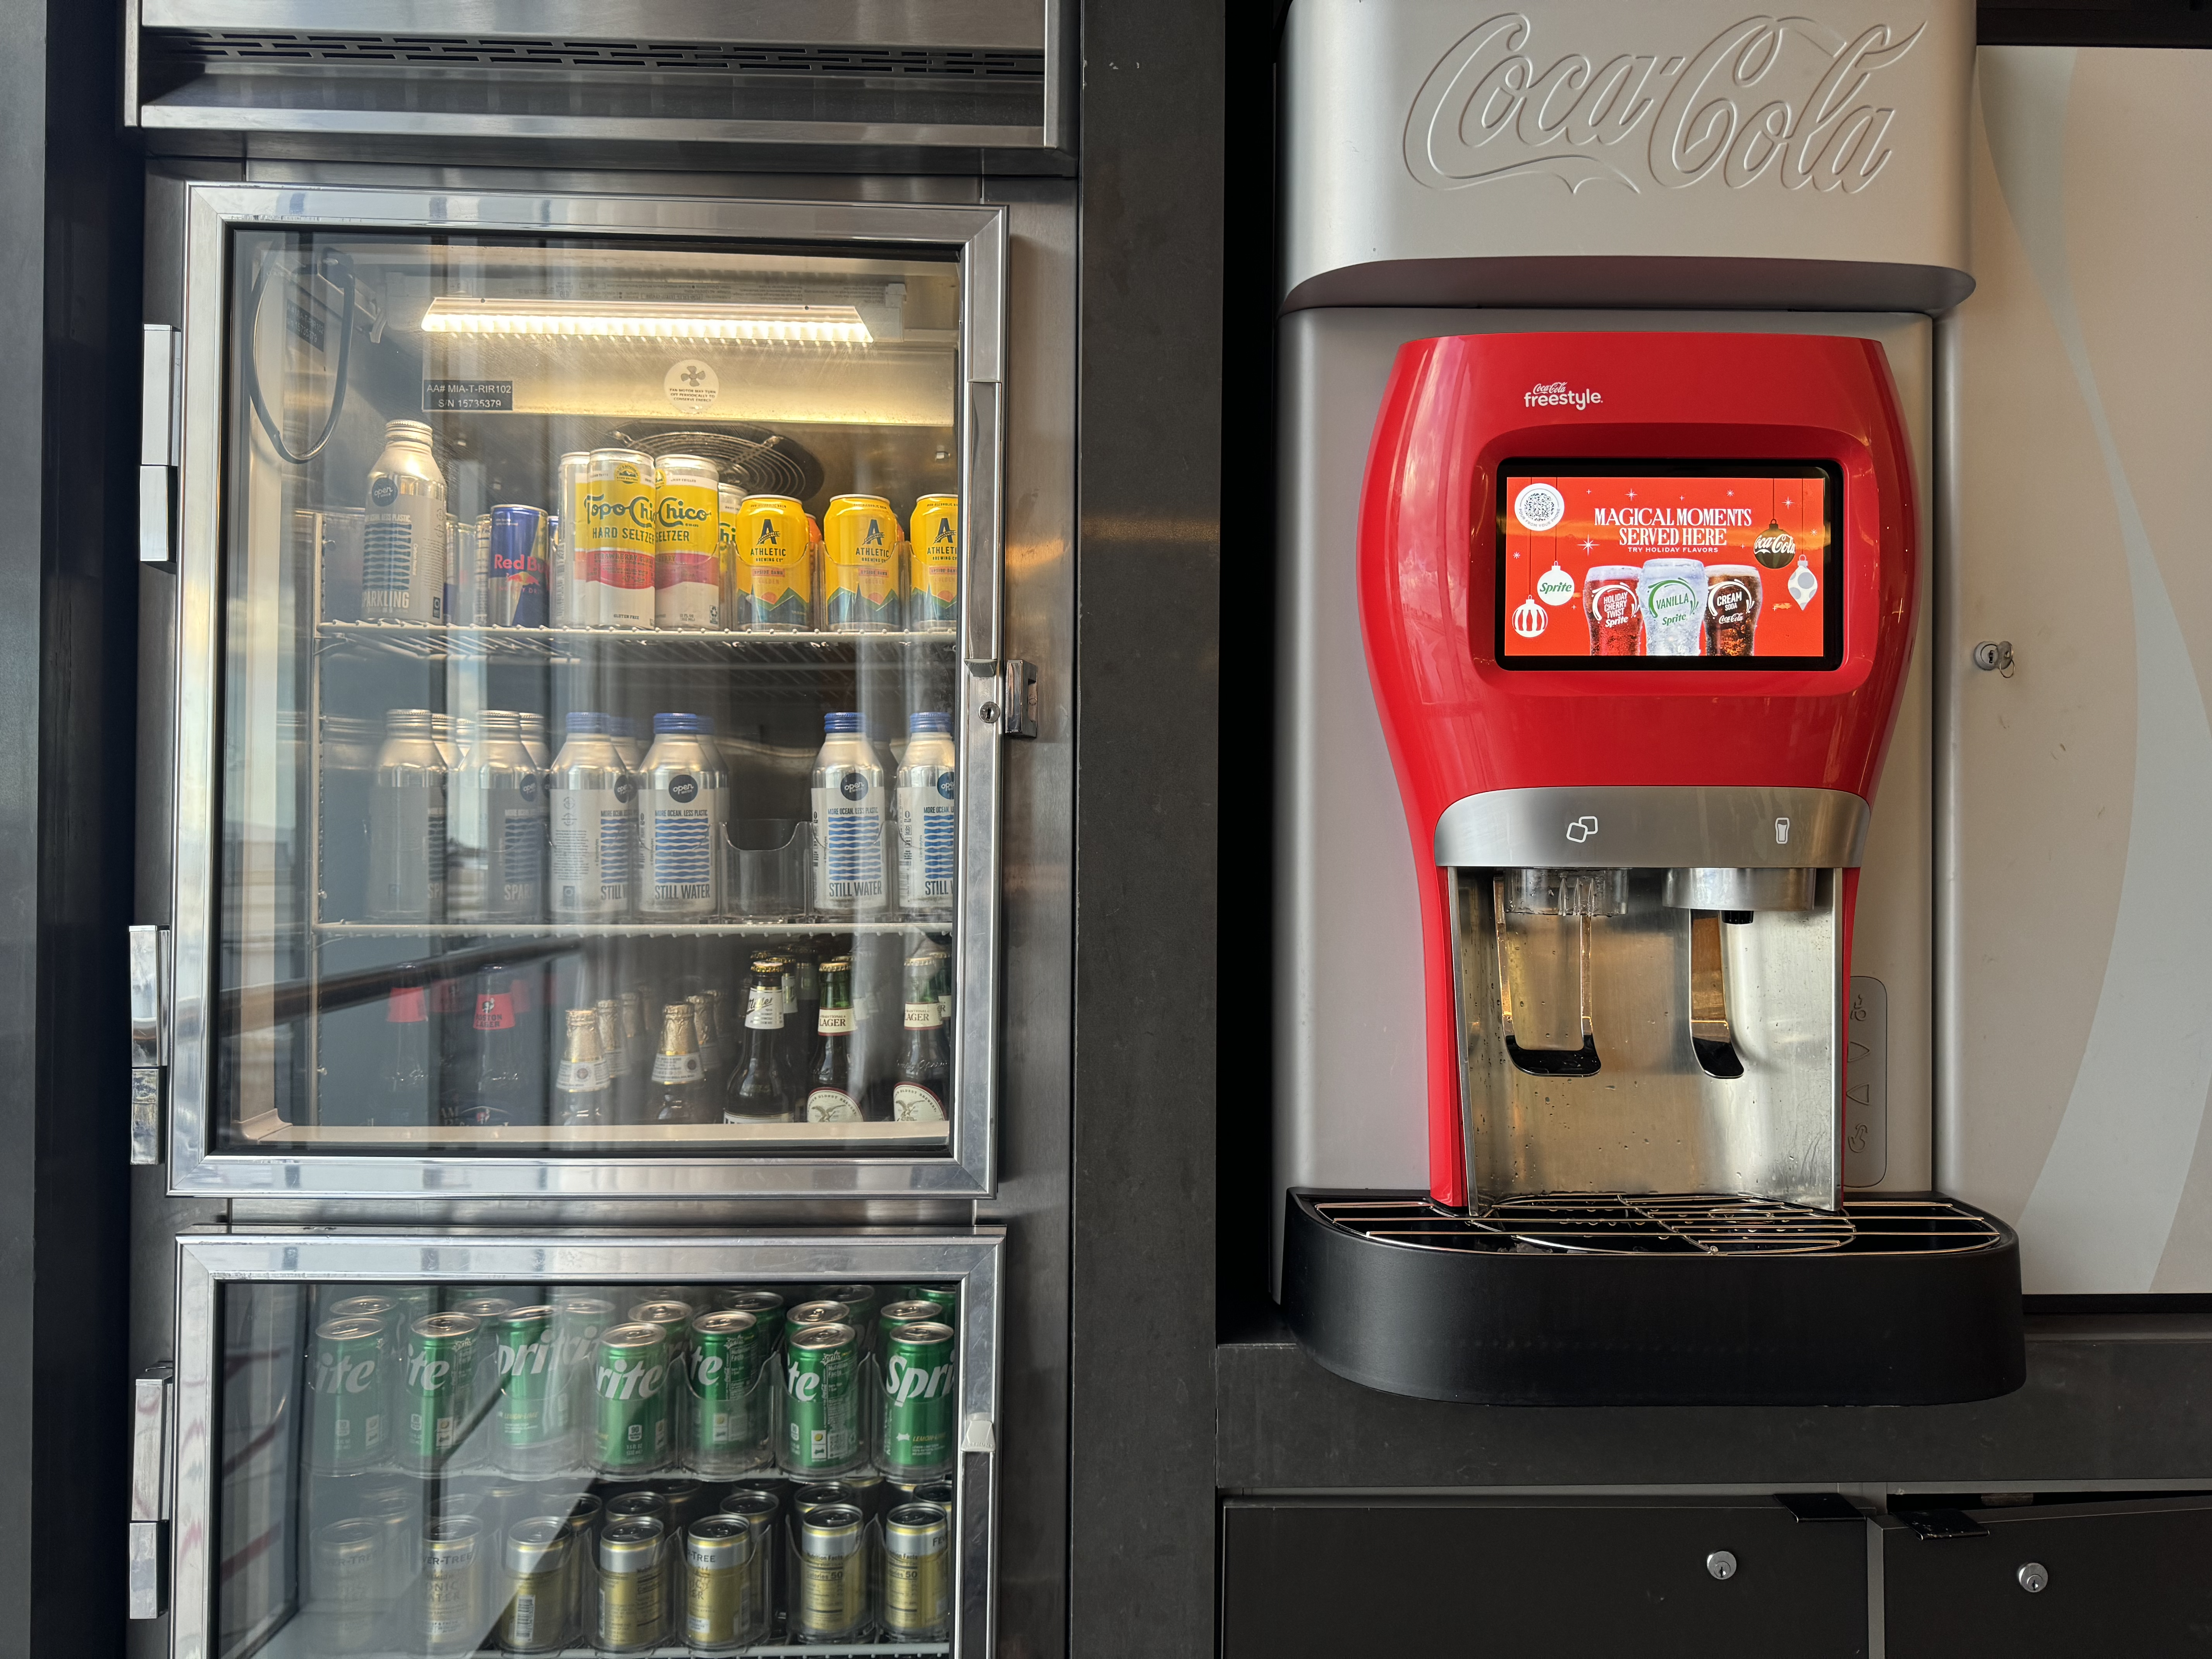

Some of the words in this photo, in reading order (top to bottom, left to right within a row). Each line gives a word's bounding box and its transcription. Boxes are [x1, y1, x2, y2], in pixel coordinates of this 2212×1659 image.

[1403, 13, 1927, 194] Coca-Cola
[448, 385, 511, 393] MIA-T-RIR102
[1533, 382, 1568, 395] Coca-Cola
[438, 399, 454, 407] S/N
[374, 486, 393, 498] open
[584, 493, 625, 524] Topo
[629, 496, 655, 528] Chi
[659, 497, 711, 528] Chico
[1551, 508, 1561, 522] PHONE
[1594, 508, 1674, 526] MAGICAL
[1677, 508, 1752, 527] MOMENTS
[593, 527, 618, 539] HARD
[1619, 528, 1679, 546] SERVED
[1682, 528, 1727, 546] HERE
[927, 546, 957, 555] ATHLETI
[1753, 534, 1796, 554] Coca-Cola
[750, 548, 786, 556] ATHLETIC
[855, 547, 889, 558] ATHLETIC
[494, 554, 524, 569] Red
[527, 556, 548, 574] Bu
[1539, 581, 1572, 594] Sprite
[1603, 591, 1628, 605] HOLIDAY
[1656, 593, 1689, 610] VANILLA
[1716, 591, 1743, 607] CREAM
[1604, 599, 1627, 613] CHERRY
[1606, 607, 1625, 619] TWIST
[1724, 602, 1738, 611] SODA
[1605, 616, 1629, 628] Sprite
[1662, 613, 1687, 626] Sprite
[1718, 613, 1744, 624] Coca-Cola
[673, 783, 694, 795] open
[845, 782, 865, 793] open
[941, 781, 955, 792] ope
[601, 884, 622, 900] STILL
[655, 885, 679, 900] STILL
[681, 884, 710, 899] WATER
[829, 883, 852, 897] STILL
[854, 881, 882, 896] WATER
[925, 881, 949, 895] STILL
[840, 1098, 857, 1115] BREWERY
[919, 1093, 937, 1111] BREWERY
[316, 1352, 375, 1394] ite
[597, 1358, 663, 1400] rite
[886, 1355, 954, 1407] Spri
[423, 1552, 473, 1565] VER-TREE
[689, 1551, 716, 1563] -TREE
